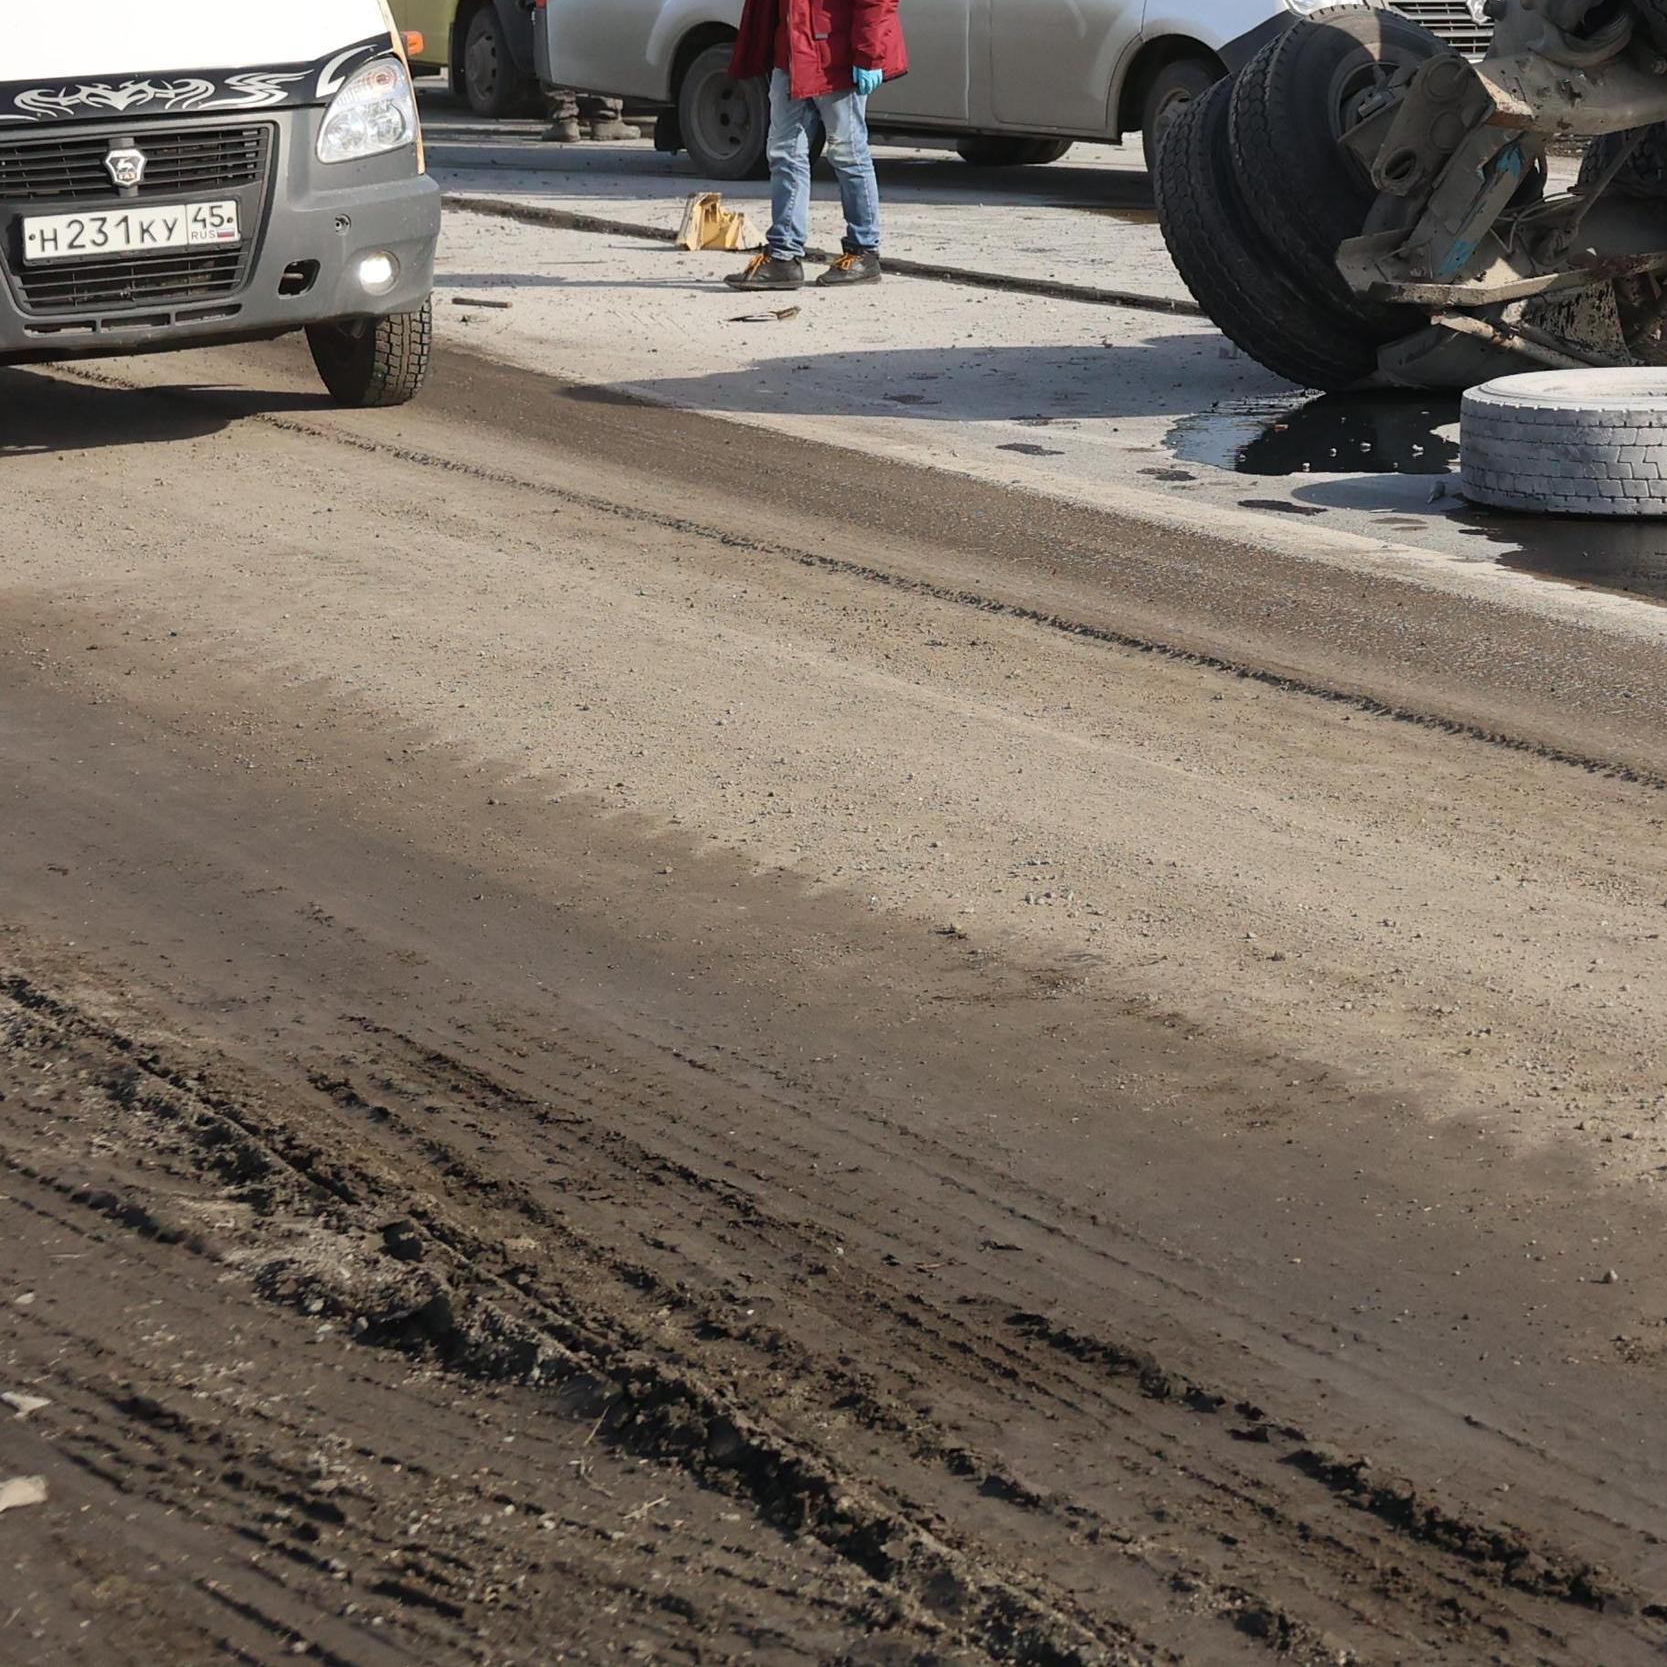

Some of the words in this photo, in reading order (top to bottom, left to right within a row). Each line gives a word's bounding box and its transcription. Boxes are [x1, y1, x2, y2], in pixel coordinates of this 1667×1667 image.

[40, 214, 179, 253] Н231КУ
[192, 204, 225, 230] 45
[191, 229, 216, 240] RUS
